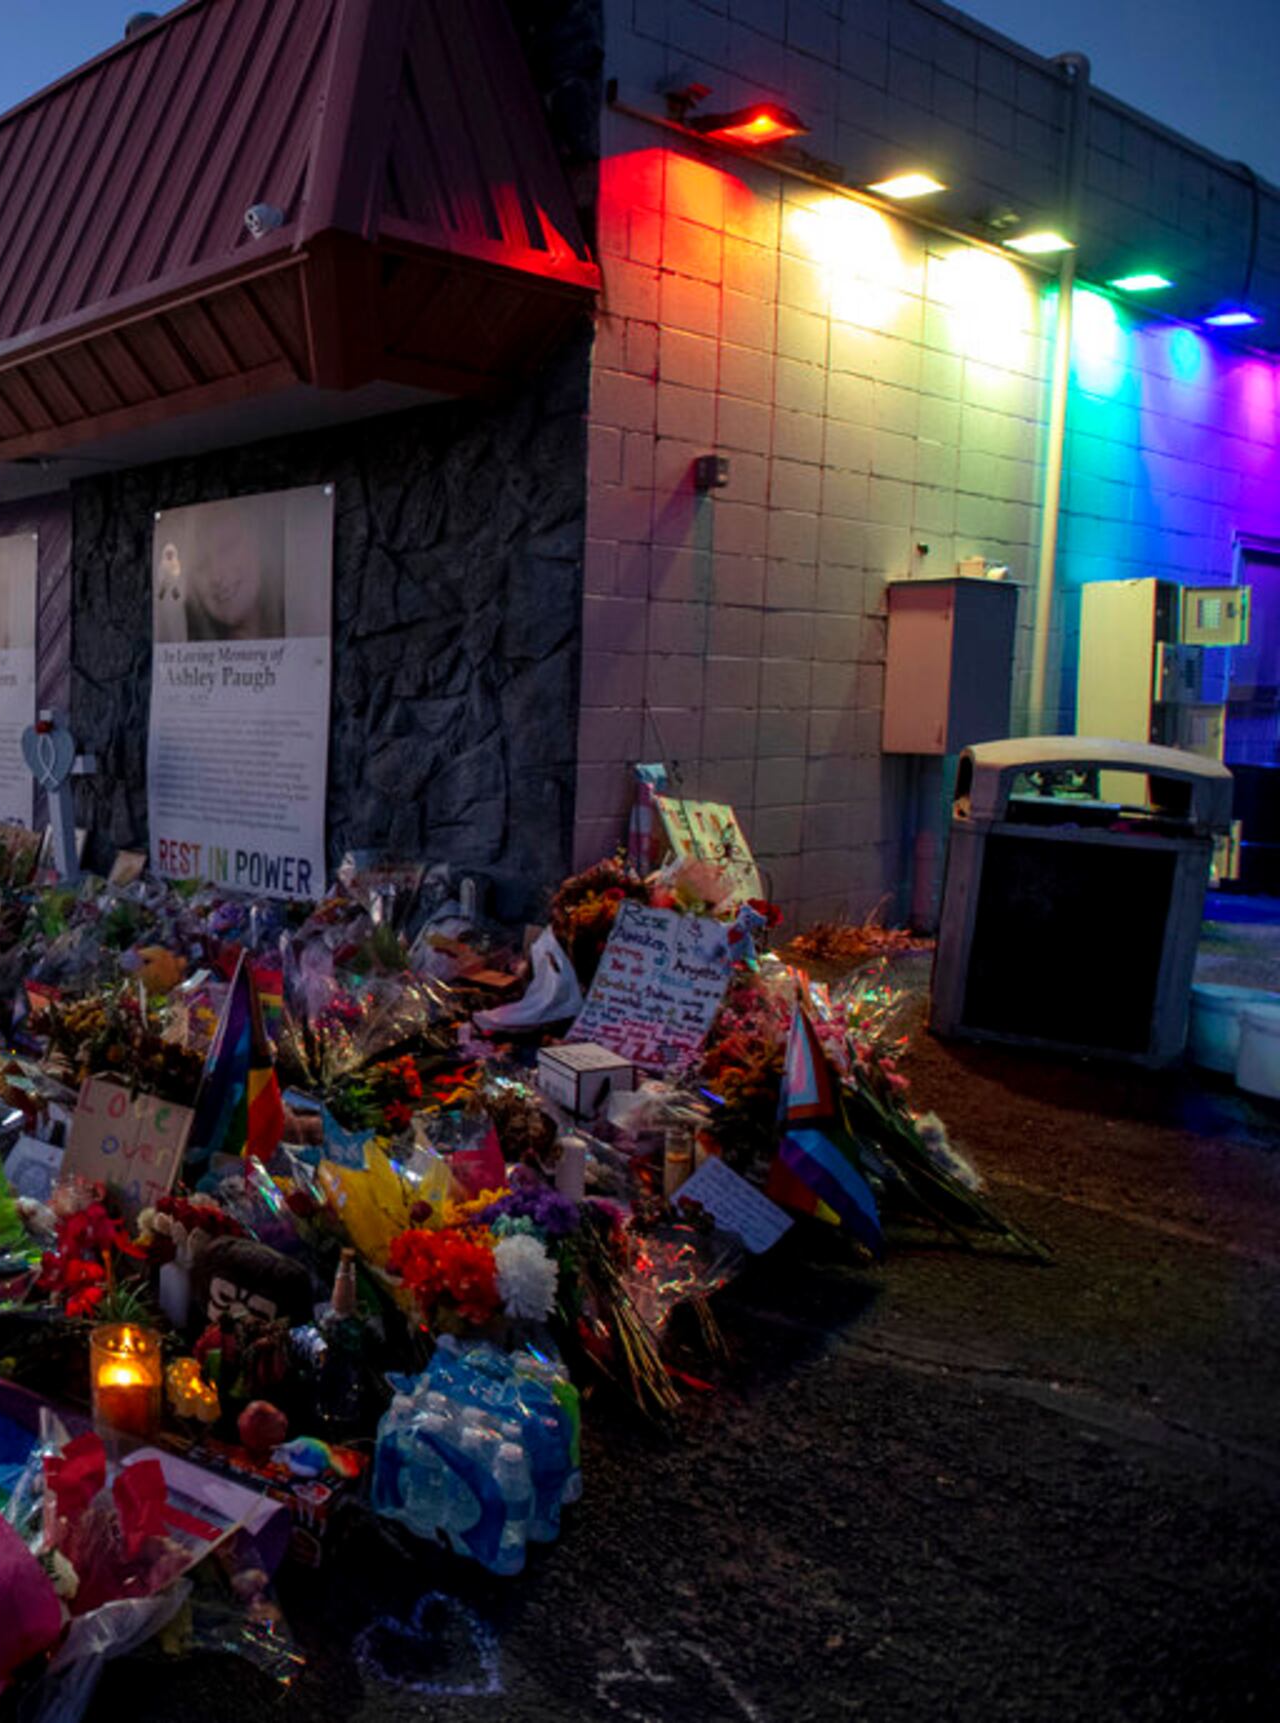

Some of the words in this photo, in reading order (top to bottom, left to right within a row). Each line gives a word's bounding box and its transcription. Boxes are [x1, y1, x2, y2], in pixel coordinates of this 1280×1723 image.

[219, 647, 267, 665] Memory
[164, 667, 215, 693] Ashley
[222, 666, 276, 693] Paugh
[158, 838, 202, 876] REST
[208, 845, 228, 881] IN
[235, 849, 312, 895] POWER
